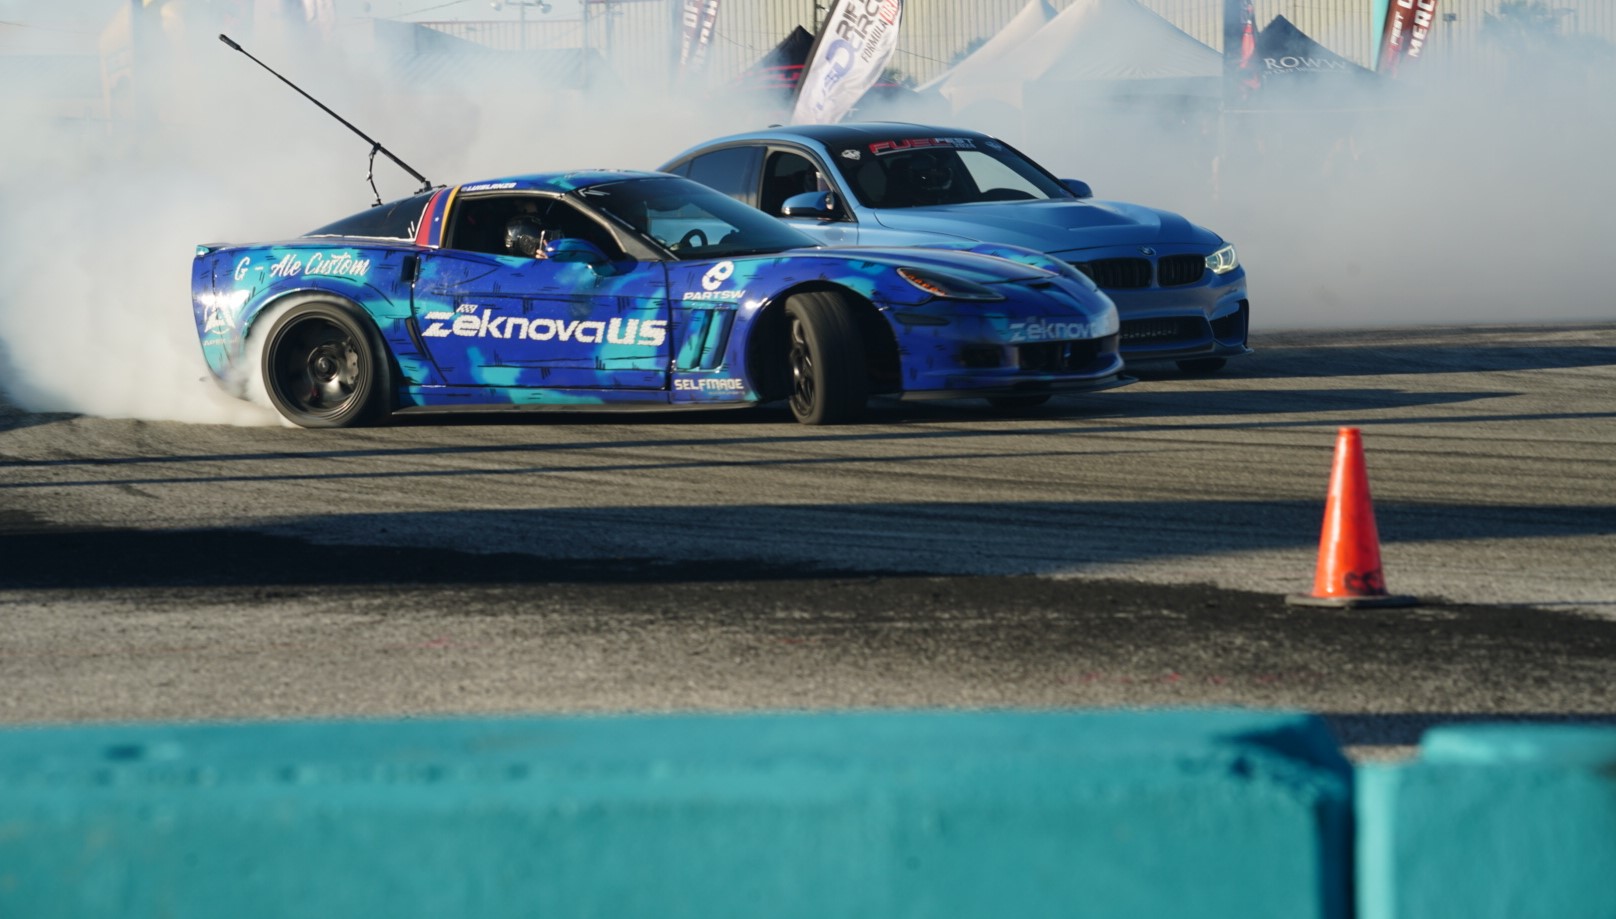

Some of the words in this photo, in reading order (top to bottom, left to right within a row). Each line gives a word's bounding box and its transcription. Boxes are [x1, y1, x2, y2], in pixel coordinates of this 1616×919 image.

[234, 256, 251, 281] G
[270, 254, 302, 277] Ale
[304, 251, 371, 276] Custom
[674, 378, 744, 392] SELFMADE
